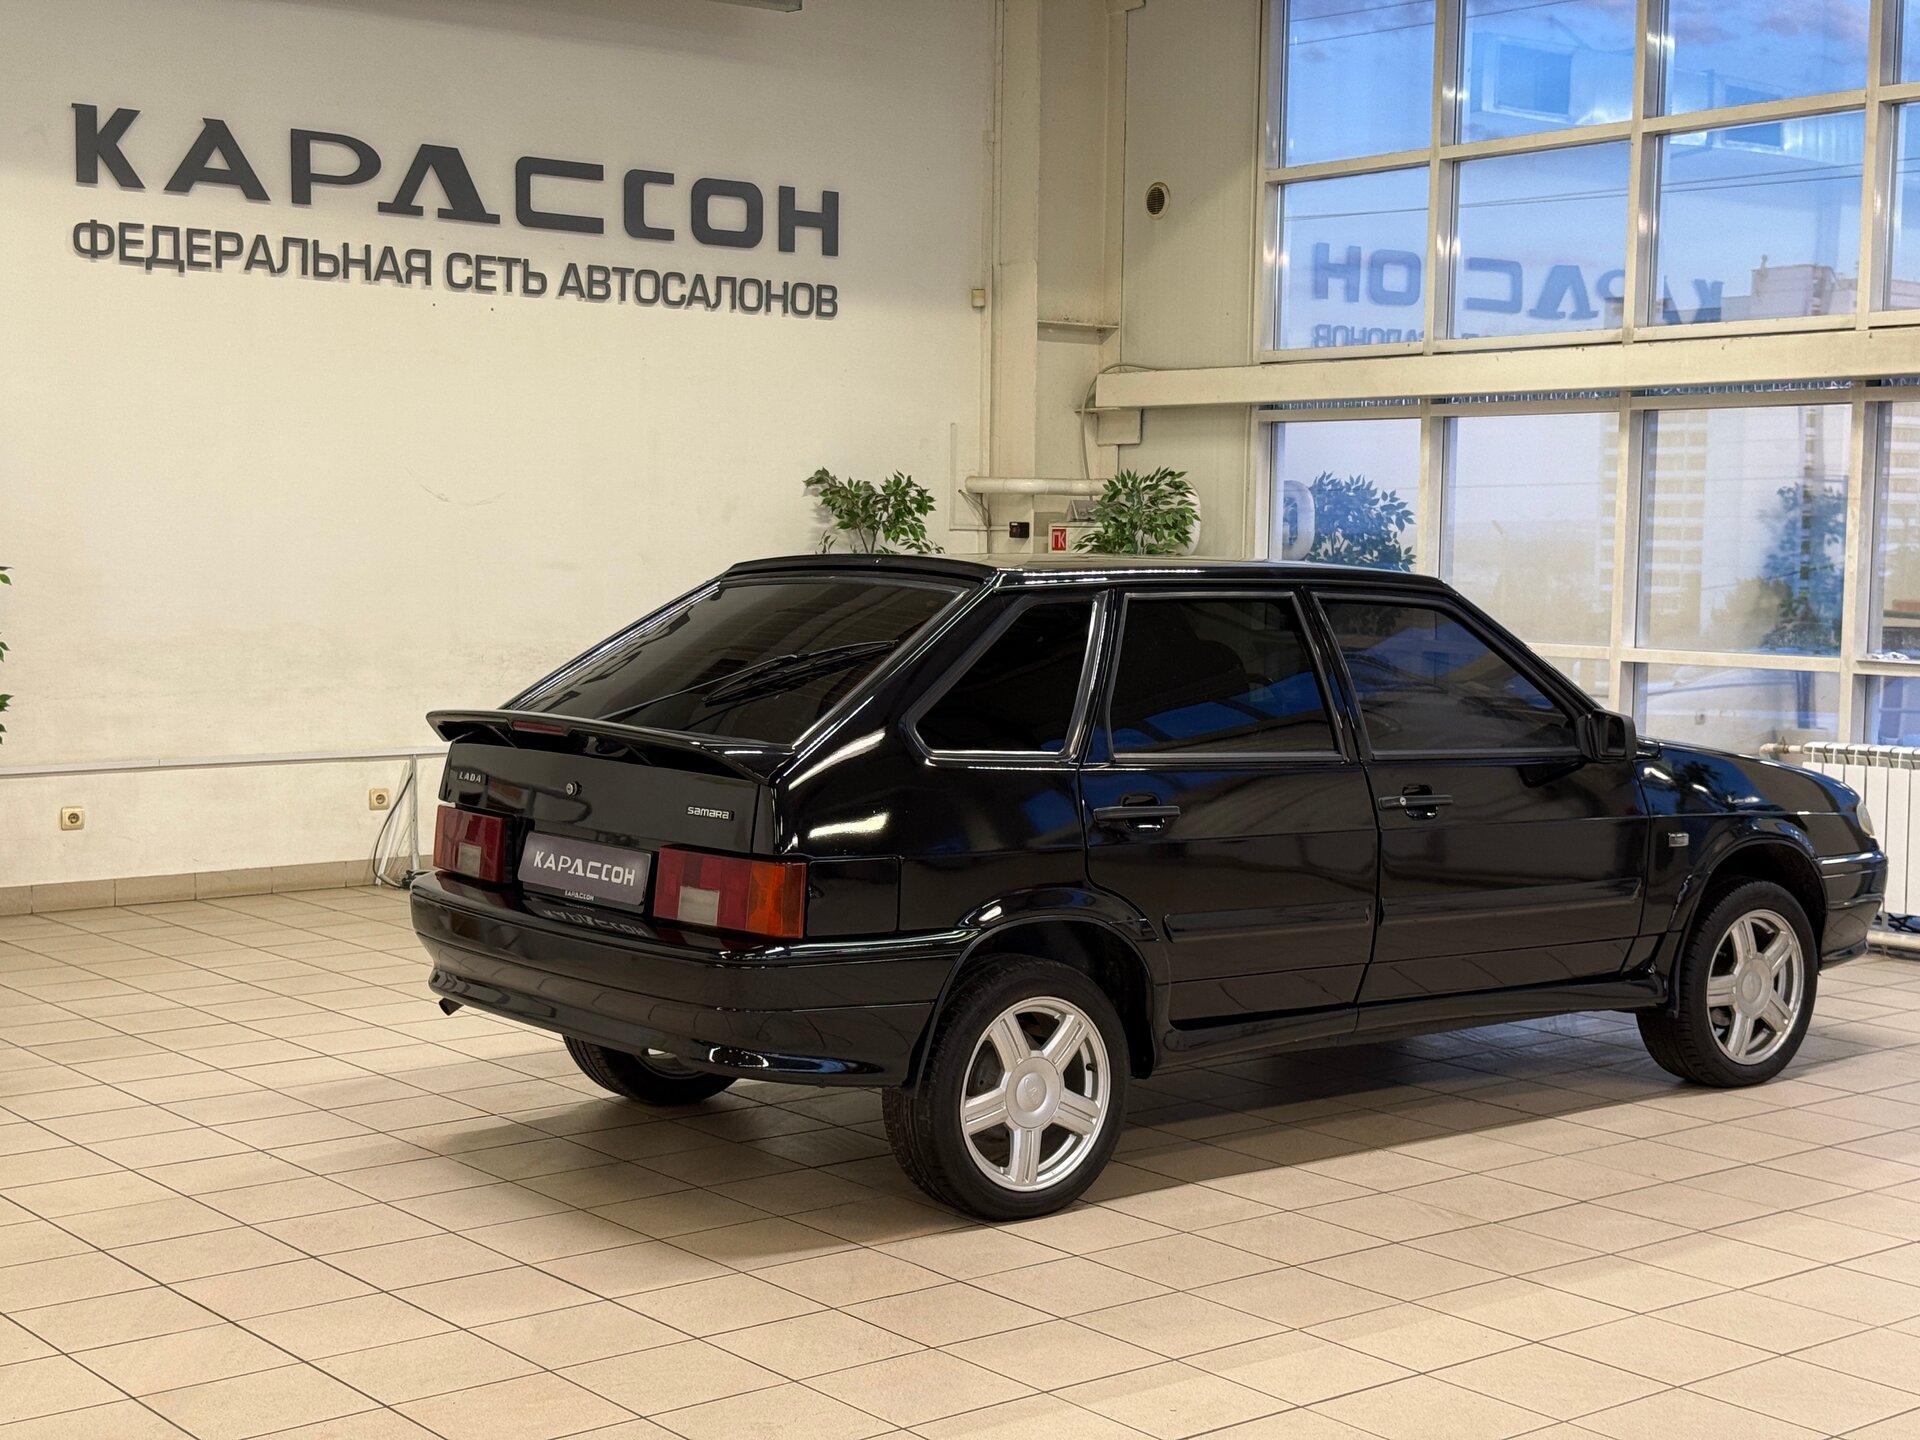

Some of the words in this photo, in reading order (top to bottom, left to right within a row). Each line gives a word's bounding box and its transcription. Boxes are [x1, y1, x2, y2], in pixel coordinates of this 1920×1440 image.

[73, 219, 432, 286] ФЕДЕРАЛЬНАЯ
[446, 252, 547, 295] СЕТЬ
[558, 263, 838, 318] АВТОСАЛОНОВ
[1052, 530, 1066, 549] ПК
[458, 771, 482, 783] LADA
